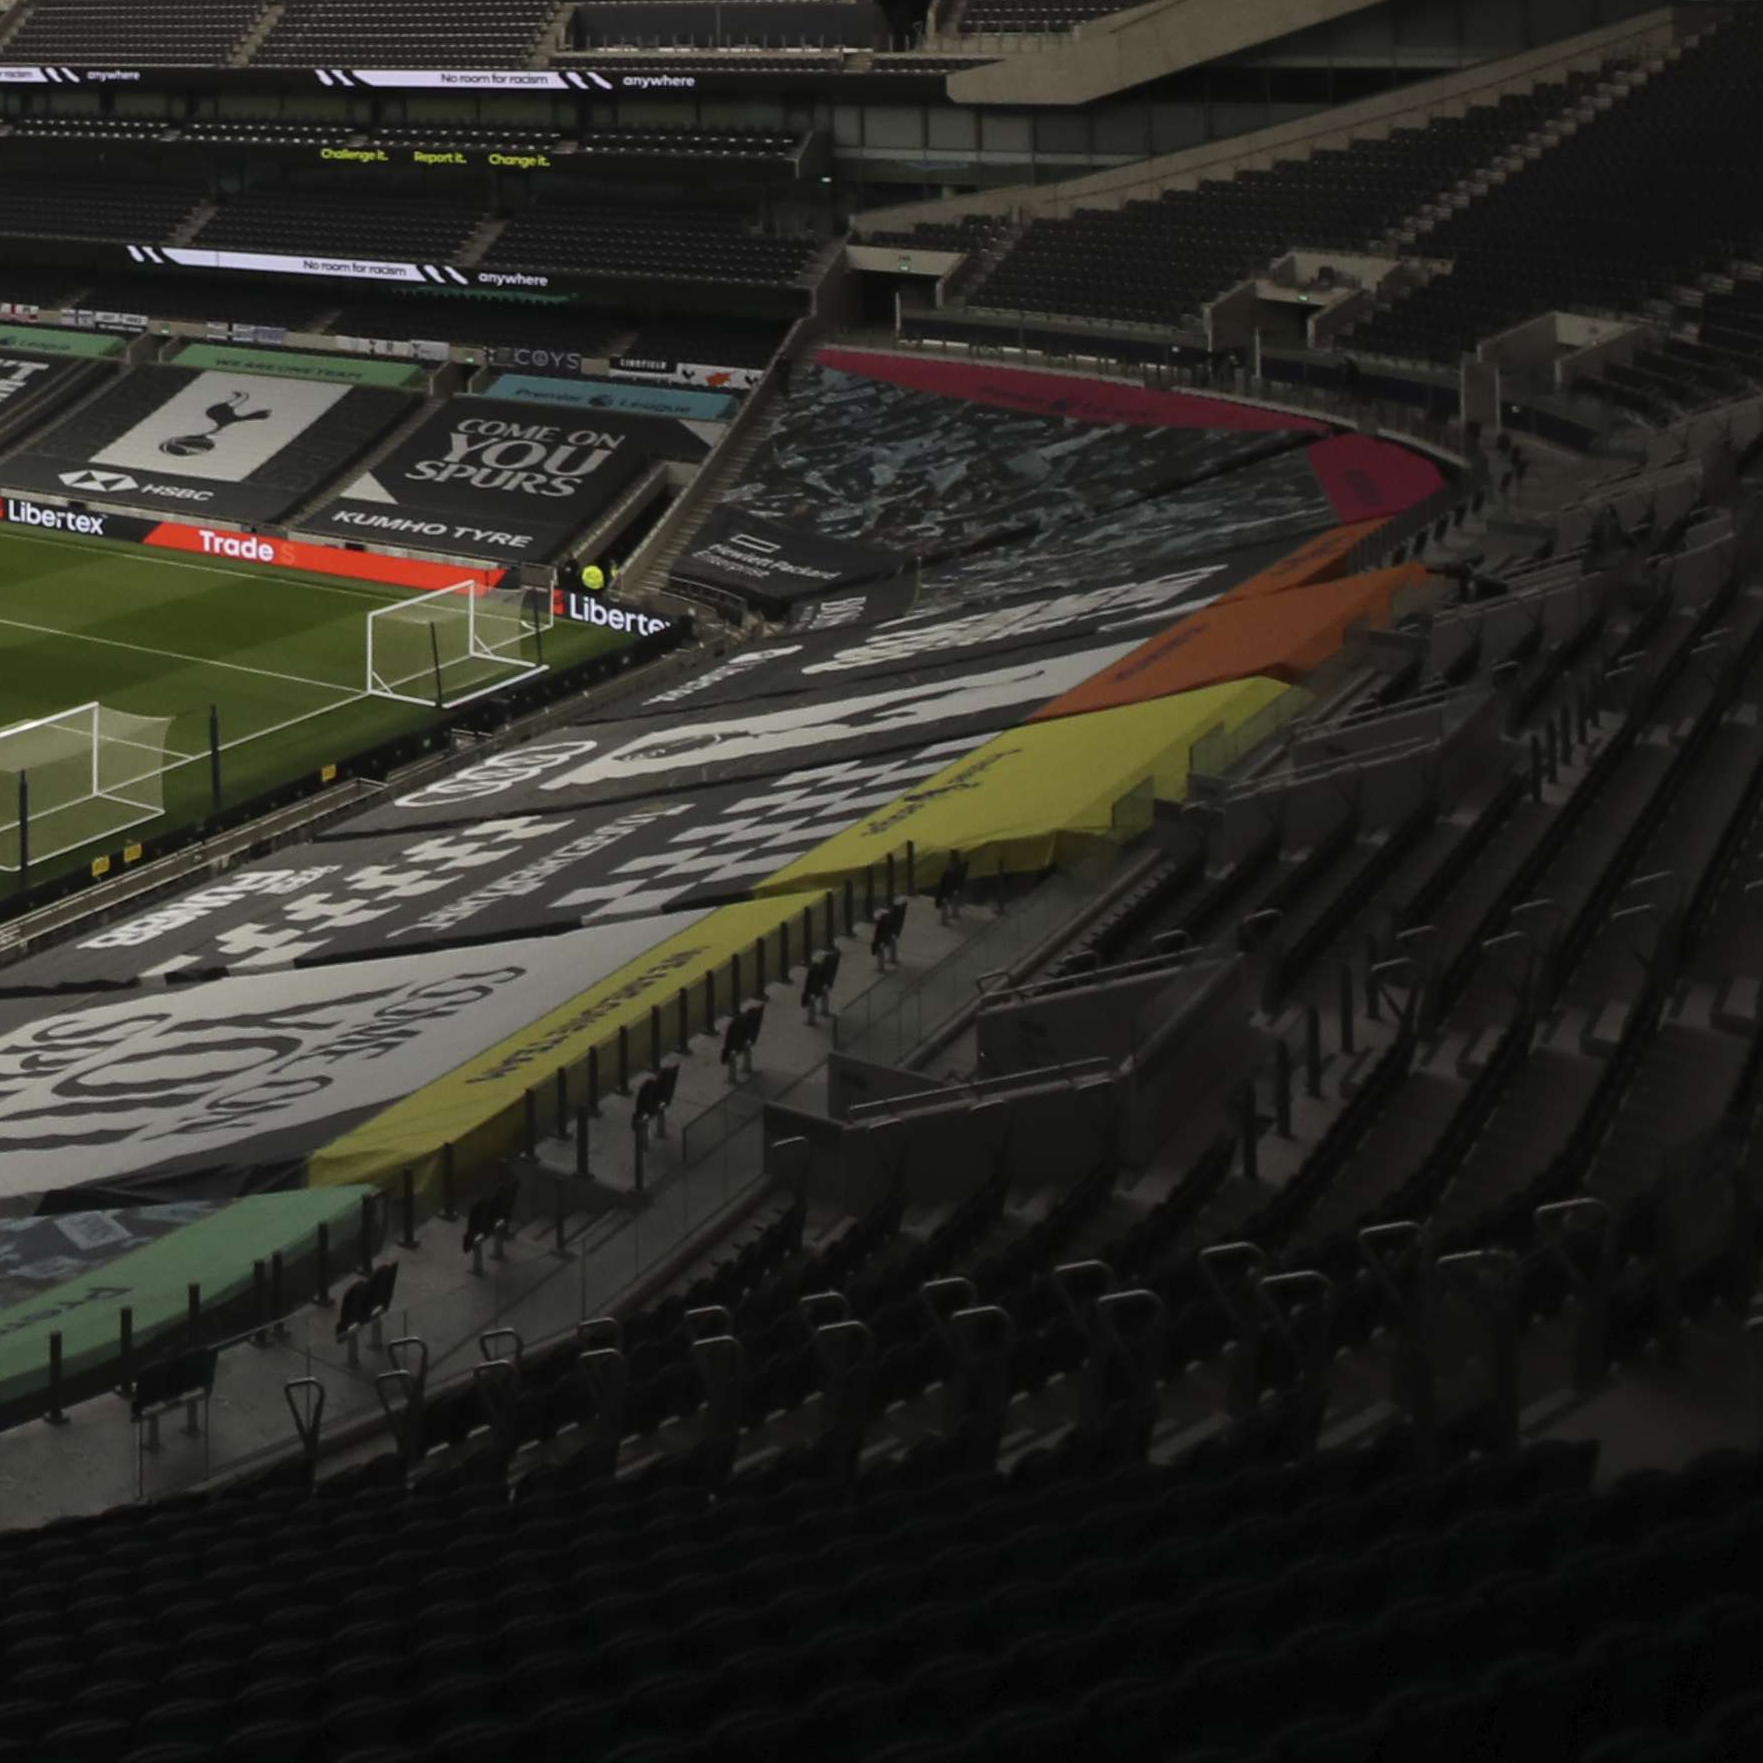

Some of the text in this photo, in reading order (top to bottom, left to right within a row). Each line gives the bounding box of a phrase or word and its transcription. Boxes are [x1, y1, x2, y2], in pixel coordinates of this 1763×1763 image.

[86, 69, 140, 82] anywhere
[456, 75, 490, 83] room
[492, 73, 507, 84] for
[509, 74, 548, 85] racism
[622, 74, 695, 88] anywhere
[320, 148, 374, 163] Challenge
[413, 150, 454, 164] Report
[488, 152, 535, 168] Change
[321, 263, 351, 272] room
[352, 262, 367, 273] for
[368, 265, 406, 275] racism
[477, 272, 549, 287] anywhere
[514, 348, 582, 370] COYS
[317, 368, 363, 379] TEAM
[456, 418, 627, 450] COME ON
[442, 432, 616, 477] YOU
[404, 460, 585, 497] SPURS
[140, 484, 216, 501] HSBC
[7, 500, 105, 535] Libertex
[331, 510, 535, 549] KUMHO TYRE
[197, 529, 276, 562] Trade
[569, 593, 672, 637] Liberte
